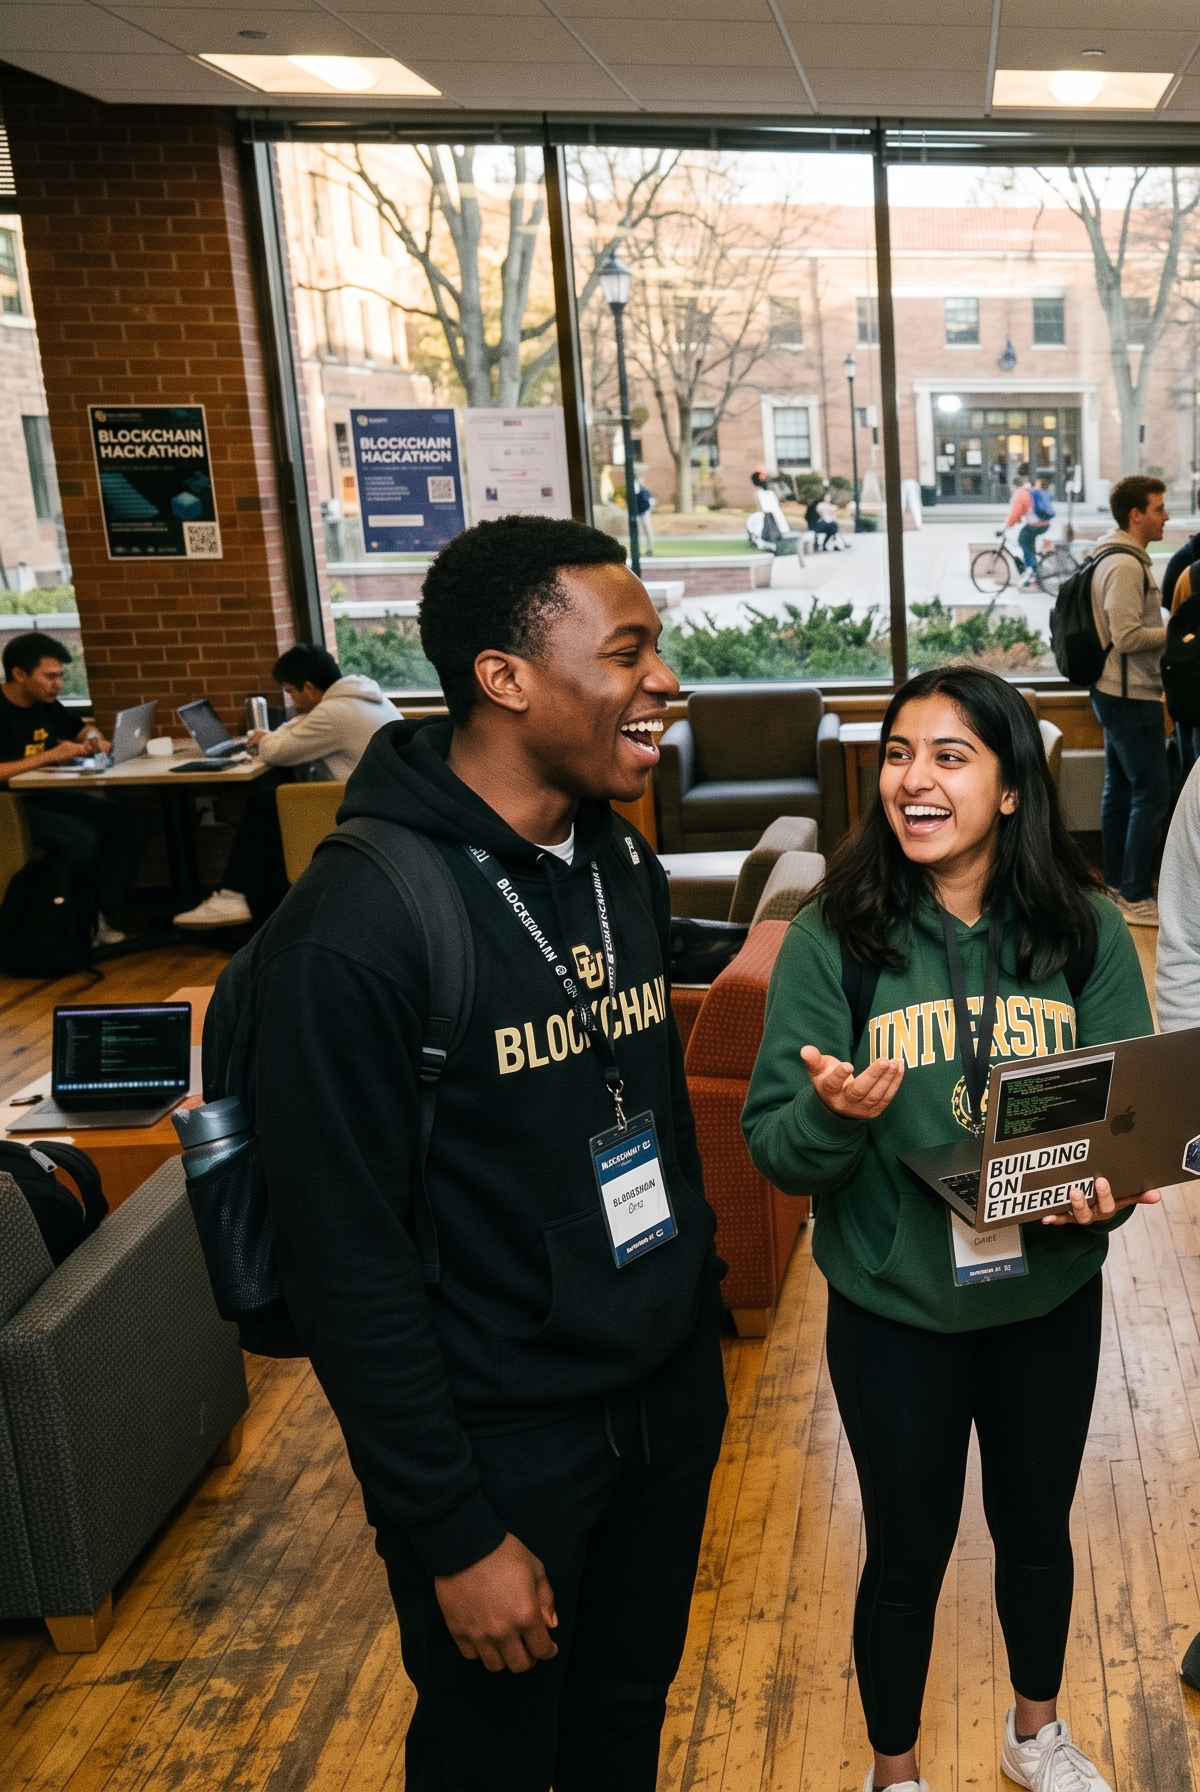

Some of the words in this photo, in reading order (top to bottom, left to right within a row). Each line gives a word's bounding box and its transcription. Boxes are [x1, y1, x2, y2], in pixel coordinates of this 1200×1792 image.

[97, 428, 203, 444] BLOCKCHAIN
[360, 436, 451, 450] BLOCKCHAIN
[100, 443, 205, 459] HACKATHON
[361, 449, 452, 463] HACKATHON
[494, 974, 667, 1075] BLOCCHAIN
[990, 1142, 1087, 1179] BUILDING
[988, 1176, 1020, 1199] ON
